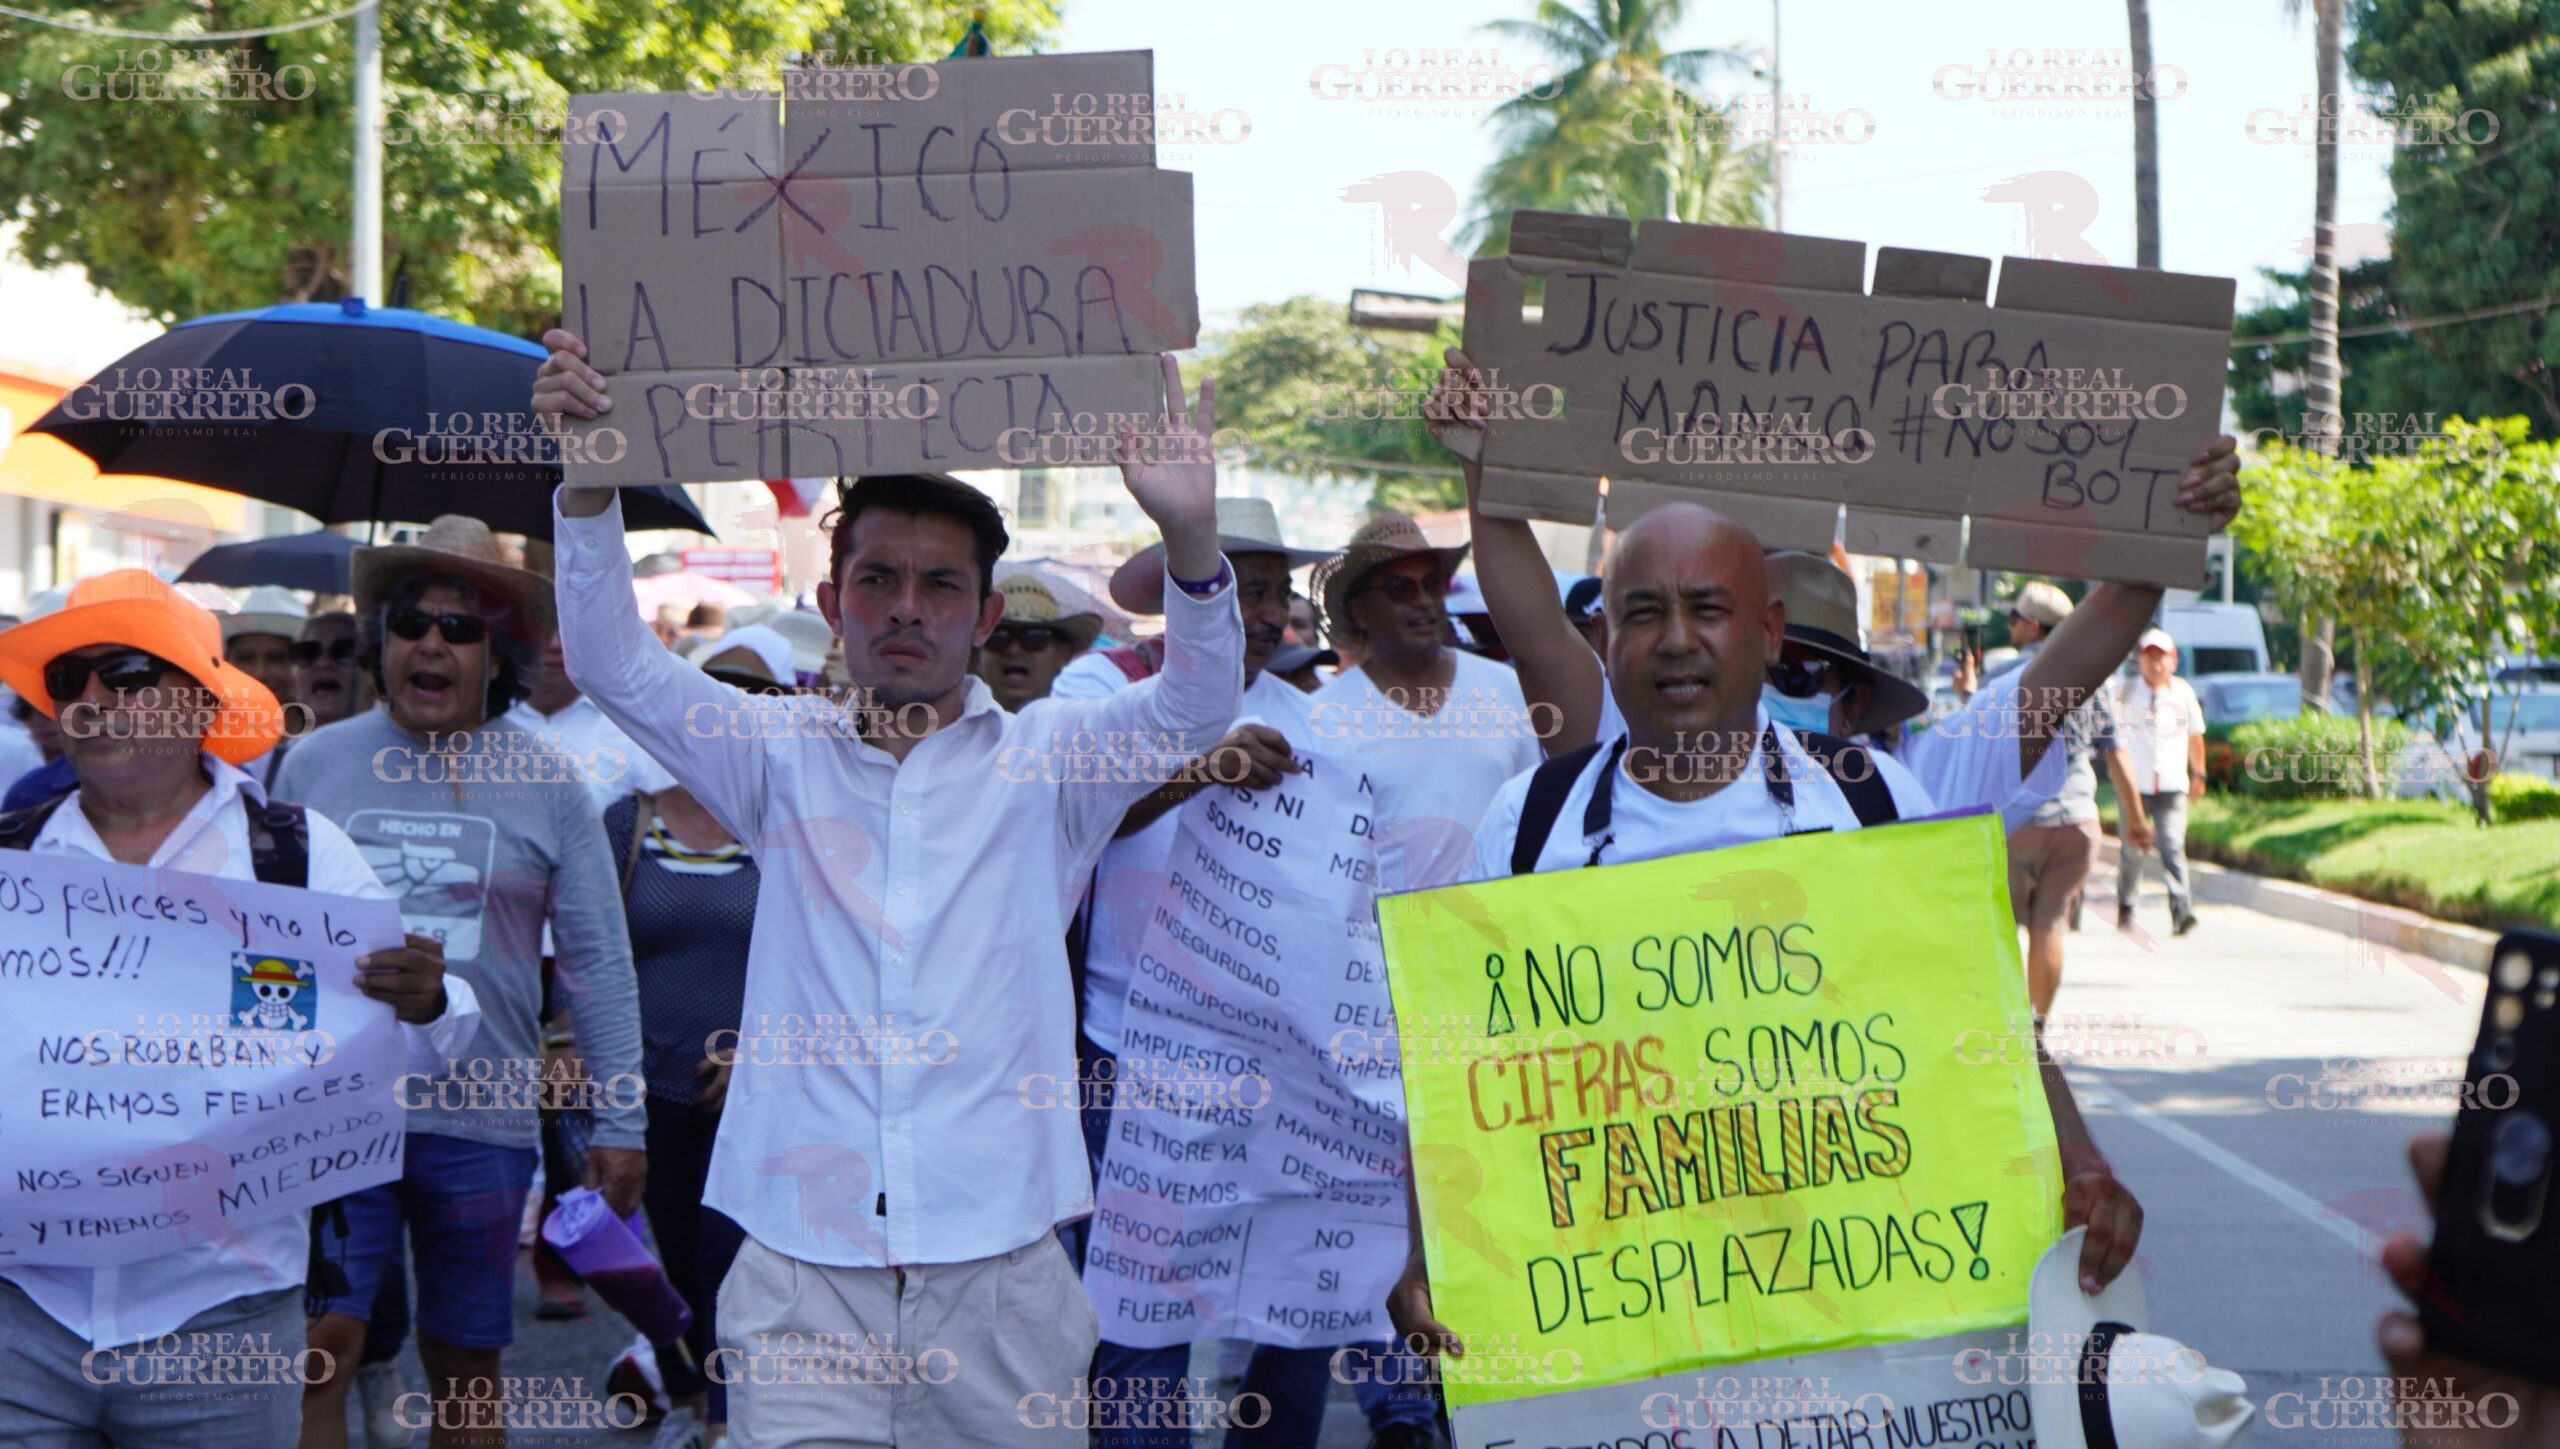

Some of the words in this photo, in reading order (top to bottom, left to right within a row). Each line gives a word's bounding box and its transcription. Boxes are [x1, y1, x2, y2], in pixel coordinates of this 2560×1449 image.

[590, 111, 1010, 238] MÉXICO
[731, 265, 1133, 366] DICTADURA
[1546, 271, 1830, 375] JUSTICIA
[1871, 322, 2062, 409] PARA
[646, 370, 1086, 482] PERFECTA
[2042, 460, 2182, 530] BOT
[378, 819, 437, 838] HECHO
[439, 822, 462, 839] EN
[1206, 800, 1283, 858] SOMOS
[1274, 792, 1304, 819] NI
[1194, 846, 1275, 911] HARTOS
[62, 877, 208, 939] felices
[323, 911, 358, 947] lo
[1169, 870, 1283, 962] PRETEXTOS,
[1154, 905, 1280, 998] INSEGURIDAD
[1632, 922, 1824, 1013] SOMOS
[1138, 953, 1280, 1034] CORRUPCIÓN
[1334, 1002, 1370, 1028] DE
[39, 1035, 111, 1067] NOS
[124, 1034, 278, 1071] ROBABAN
[1467, 1035, 1676, 1133] CIFRAS
[1705, 1012, 1907, 1098] SOMOS
[40, 1087, 180, 1125] ERAMOS
[17, 1168, 82, 1194] NOS
[97, 1159, 210, 1187] SIGUEN
[229, 1110, 385, 1168] ROBANDO
[1150, 1128, 1214, 1163] TIGRE
[1221, 1142, 1249, 1164] YA
[1538, 1088, 1912, 1229] FAMILIAS
[1104, 1158, 1151, 1195] NOS
[1157, 1181, 1241, 1206] VEMOS
[59, 1209, 190, 1238] TENEMOS
[1098, 1207, 1243, 1250] REVOCACIÓN
[1314, 1228, 1355, 1250] NO
[1088, 1246, 1233, 1285] DESTITUCIÓN
[1316, 1268, 1341, 1293] SI
[1526, 1200, 1990, 1336] DESPLAZADAS!
[1117, 1297, 1197, 1324] FUERA
[1265, 1302, 1374, 1331] MORENA
[1882, 1389, 2033, 1449] NUESTRO
